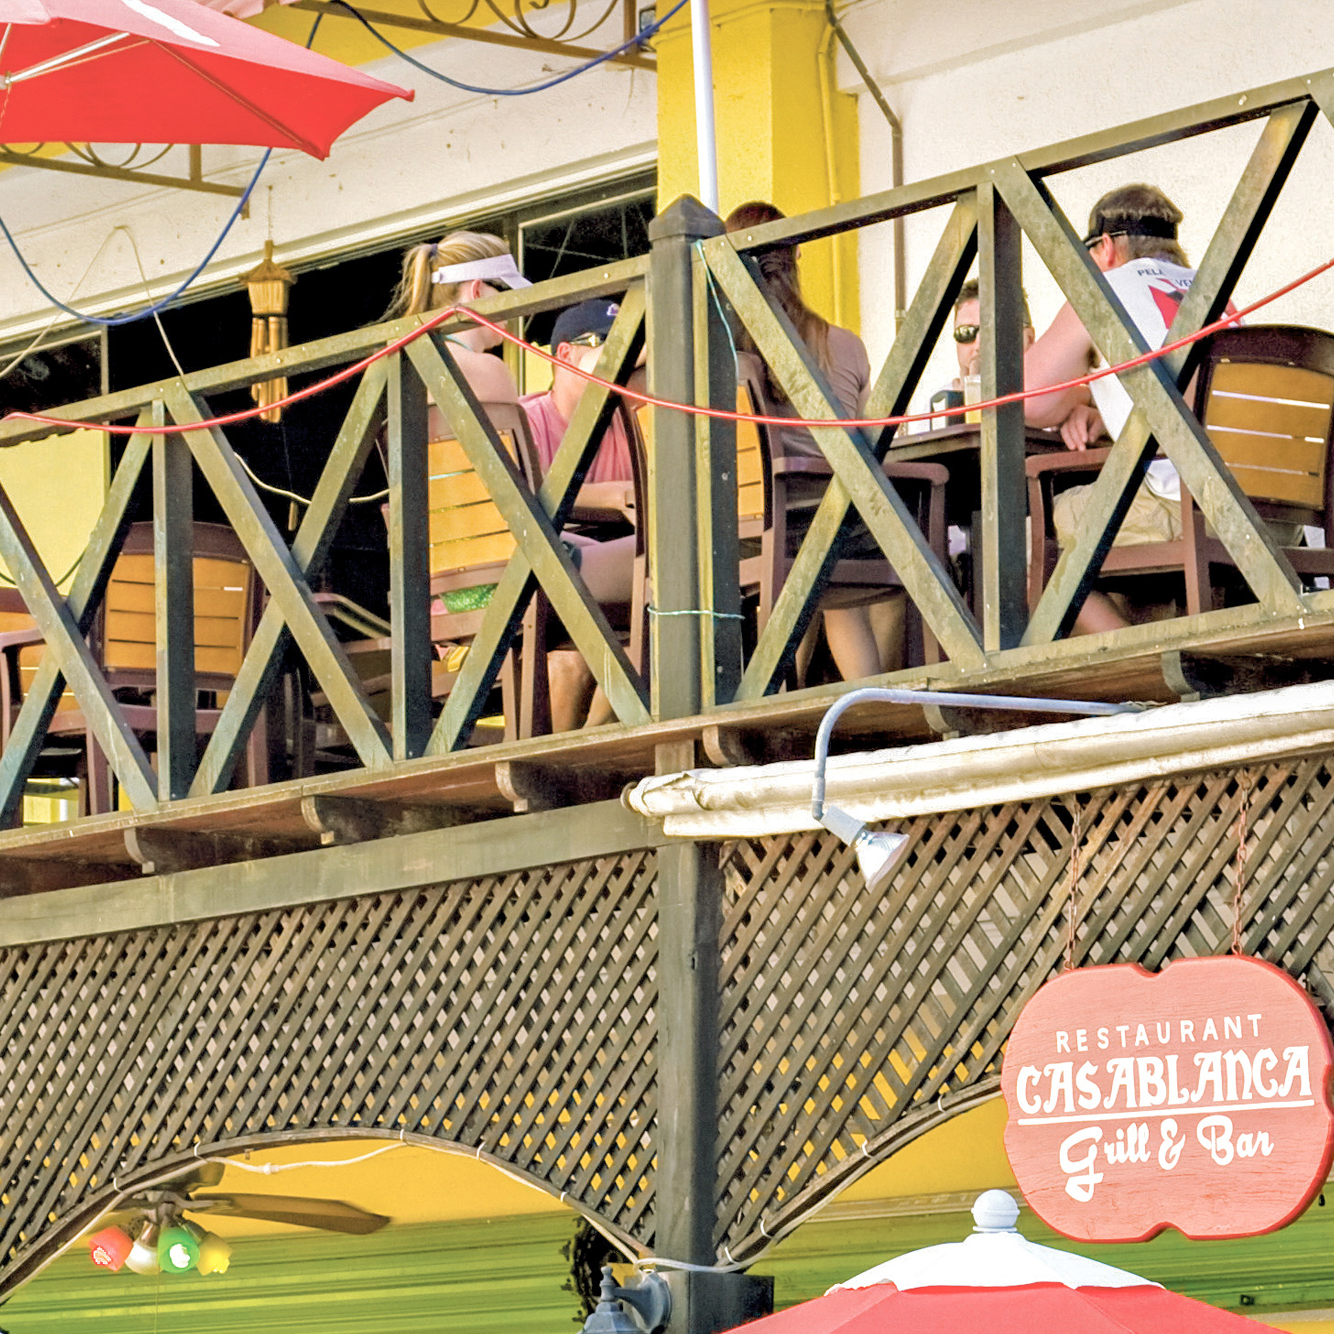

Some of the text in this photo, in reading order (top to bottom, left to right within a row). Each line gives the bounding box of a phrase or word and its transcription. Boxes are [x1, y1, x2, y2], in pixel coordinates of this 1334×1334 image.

[1055, 1013, 1263, 1053] RESTAURANT
[1017, 1045, 1313, 1114] CASABLANCA
[1059, 1114, 1274, 1202] Grill & Bar
